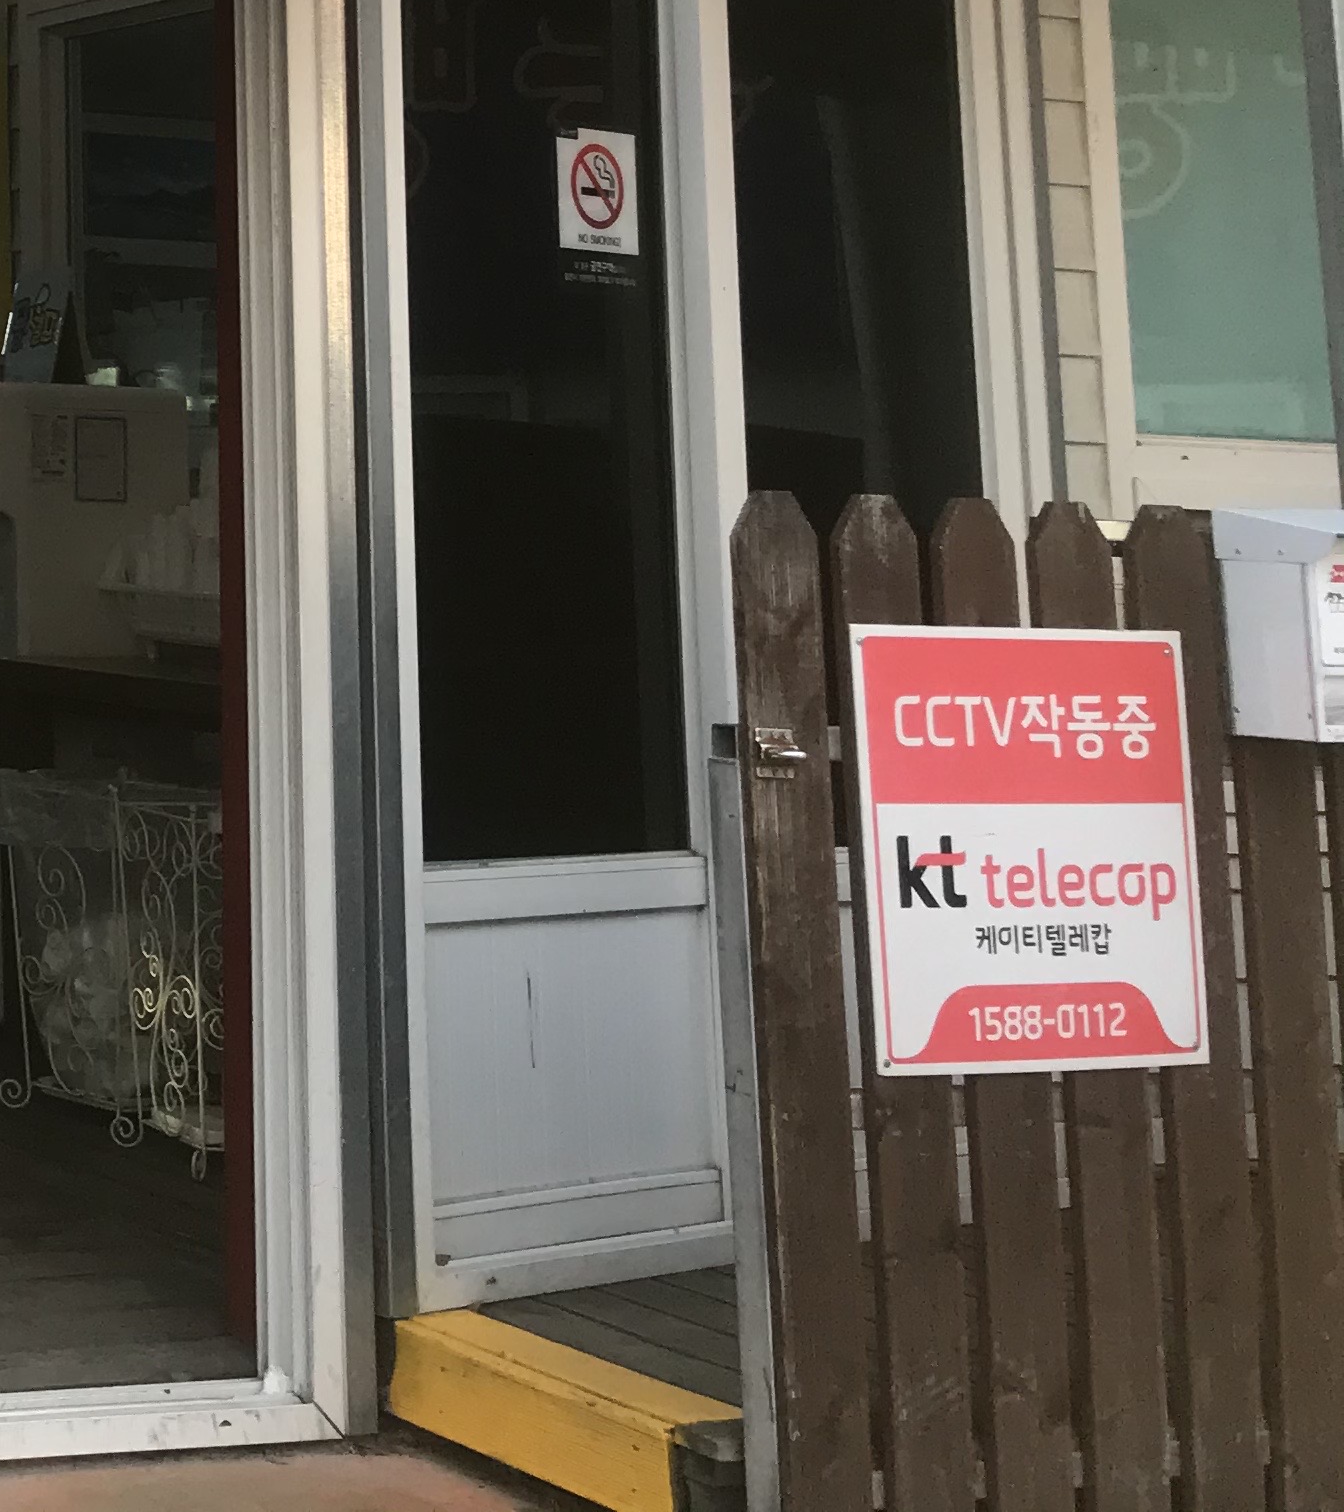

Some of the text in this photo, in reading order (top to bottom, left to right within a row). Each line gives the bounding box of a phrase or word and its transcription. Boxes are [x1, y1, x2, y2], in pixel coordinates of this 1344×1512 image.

[894, 694, 1157, 760] CCTV작동중
[896, 835, 1178, 921] kt telecop
[975, 923, 1113, 957] 케이티텔레캅
[968, 1002, 1128, 1042] 1588-0112
